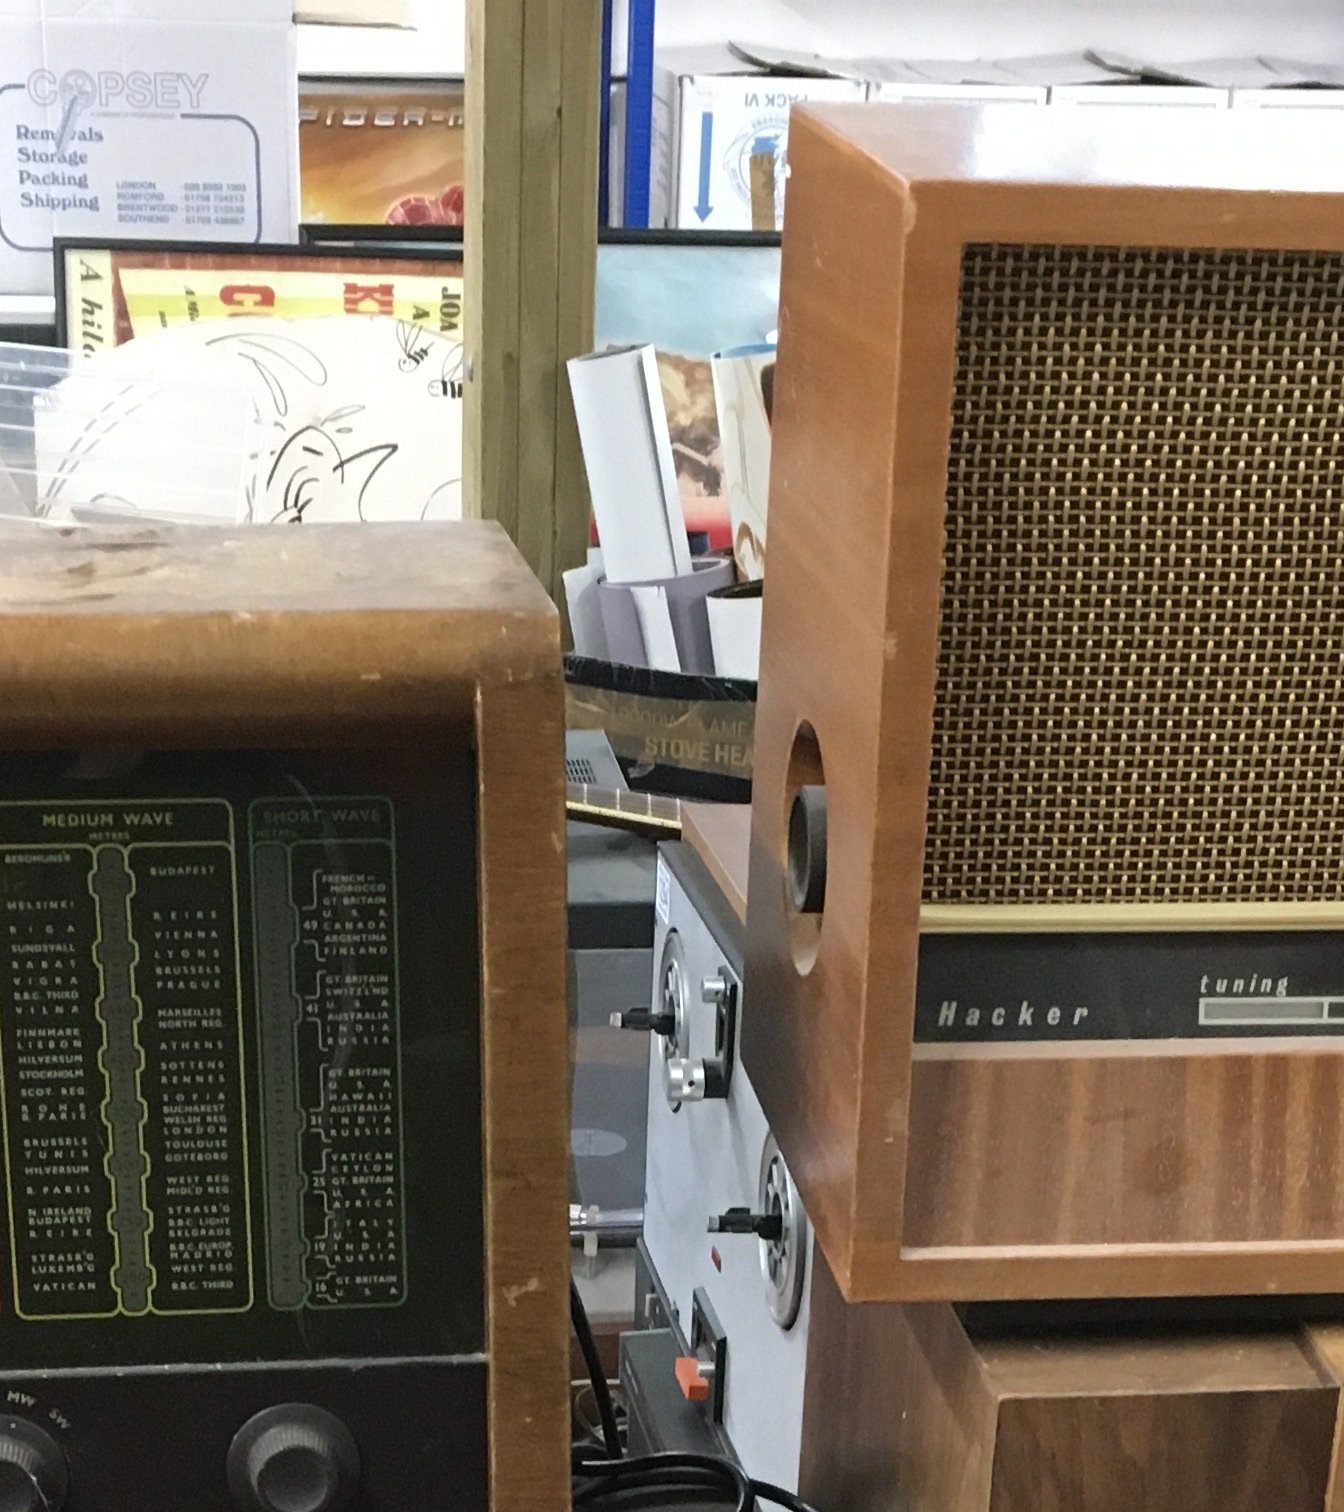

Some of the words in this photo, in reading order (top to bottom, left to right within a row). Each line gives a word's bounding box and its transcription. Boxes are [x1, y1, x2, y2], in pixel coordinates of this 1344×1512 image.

[16, 123, 104, 142] Remals
[17, 147, 89, 166] Storage
[18, 169, 89, 189] Packing
[20, 191, 100, 212] Shipping
[644, 735, 710, 765] STOVE
[42, 812, 114, 828] MEDIUM
[123, 811, 174, 827] WAVE
[331, 808, 381, 822] WAVE
[1199, 973, 1290, 999] tuning
[936, 1000, 1090, 1028] Hacker
[7, 1389, 36, 1407] MW
